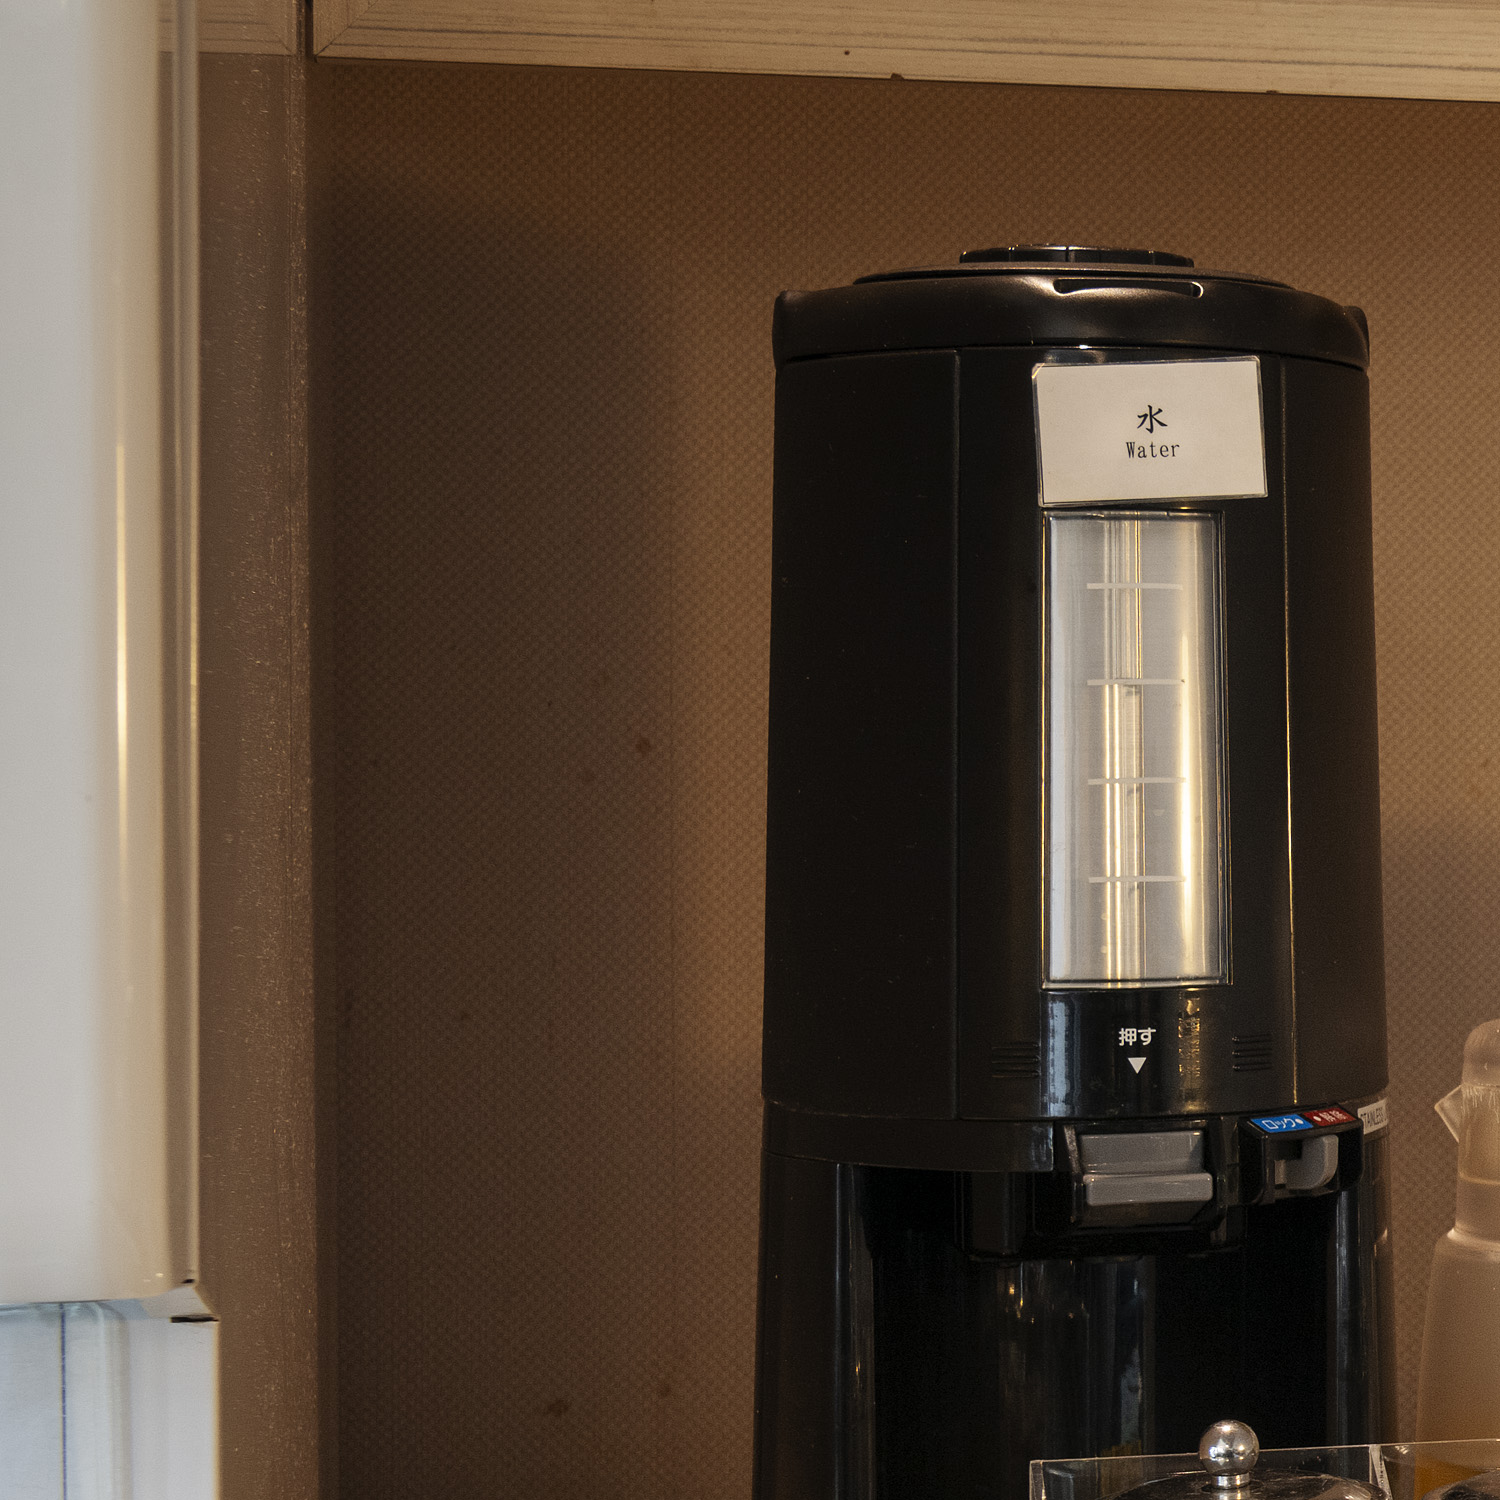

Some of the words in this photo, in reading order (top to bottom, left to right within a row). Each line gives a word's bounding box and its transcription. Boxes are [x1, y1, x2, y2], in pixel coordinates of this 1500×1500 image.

[1137, 404, 1168, 434] 水
[1126, 441, 1180, 459] Water
[1118, 1027, 1157, 1047] 押す
[1262, 1117, 1296, 1130] ロック
